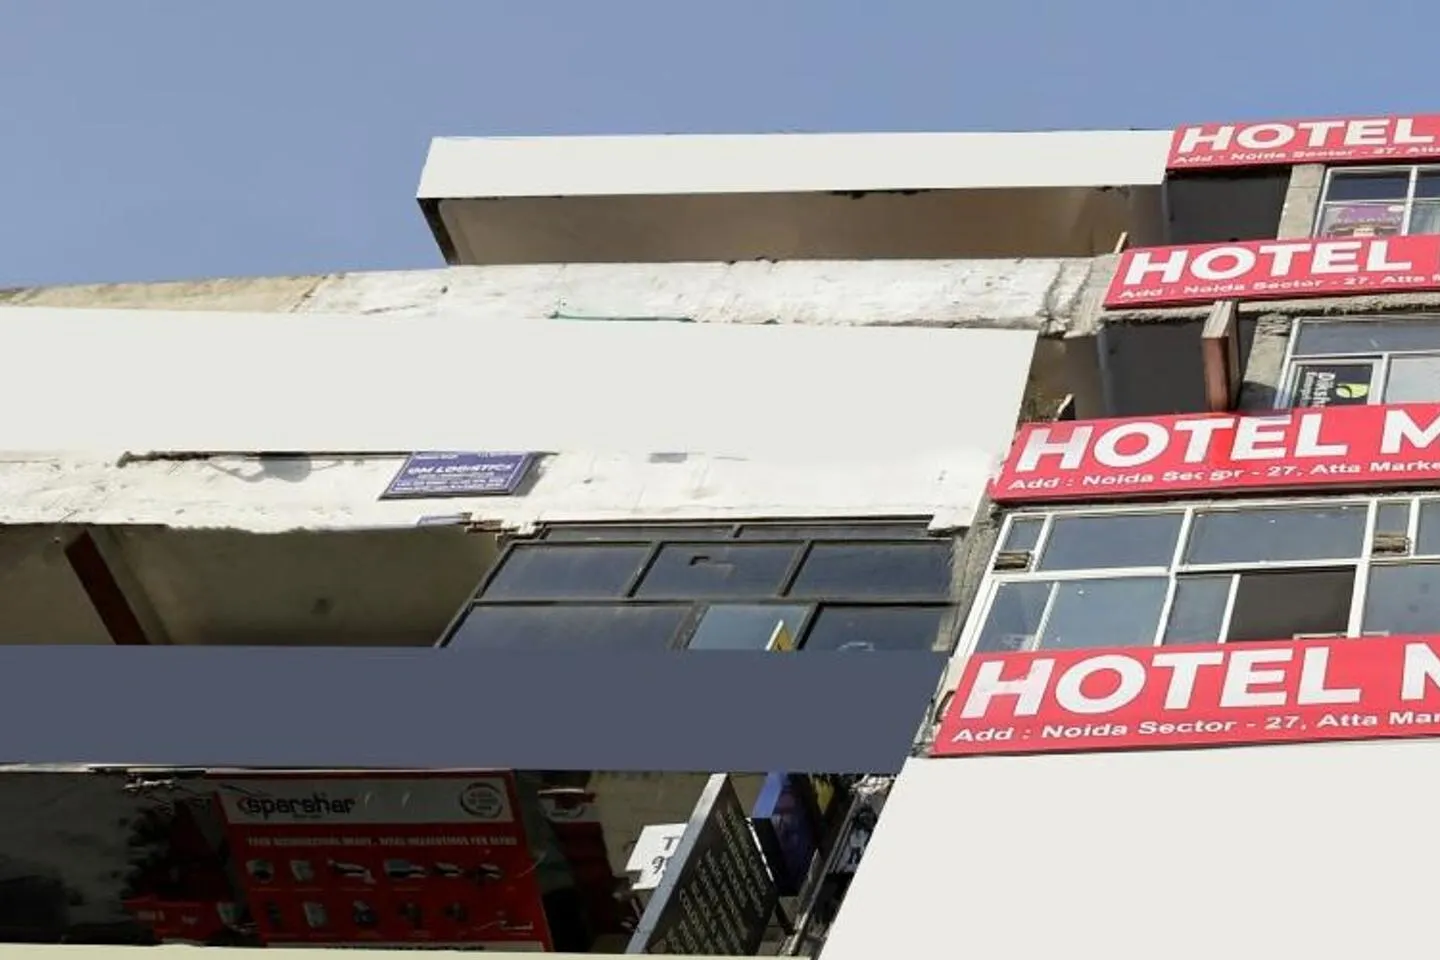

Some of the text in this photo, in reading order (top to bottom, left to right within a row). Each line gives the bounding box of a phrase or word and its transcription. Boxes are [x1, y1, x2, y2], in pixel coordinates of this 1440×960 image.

[1178, 116, 1436, 153] HOTEL
[1174, 154, 1213, 164] Add
[1230, 151, 1286, 161] Noida
[1293, 149, 1354, 159] Sector
[1123, 239, 1413, 286] HOTEL
[1120, 288, 1163, 298] Add
[1183, 284, 1246, 295] Noida
[1253, 279, 1322, 291] Sector
[1383, 274, 1425, 284] Atta
[1015, 412, 1347, 472] HOTEL
[1007, 478, 1060, 491] Add
[1082, 473, 1154, 486] Noida
[1311, 464, 1360, 475] Atta
[960, 646, 1362, 719] HOTEL
[952, 727, 1015, 742] Add
[1042, 722, 1128, 739] Noida
[1138, 718, 1235, 735] Sector
[1317, 713, 1378, 728] Atta
